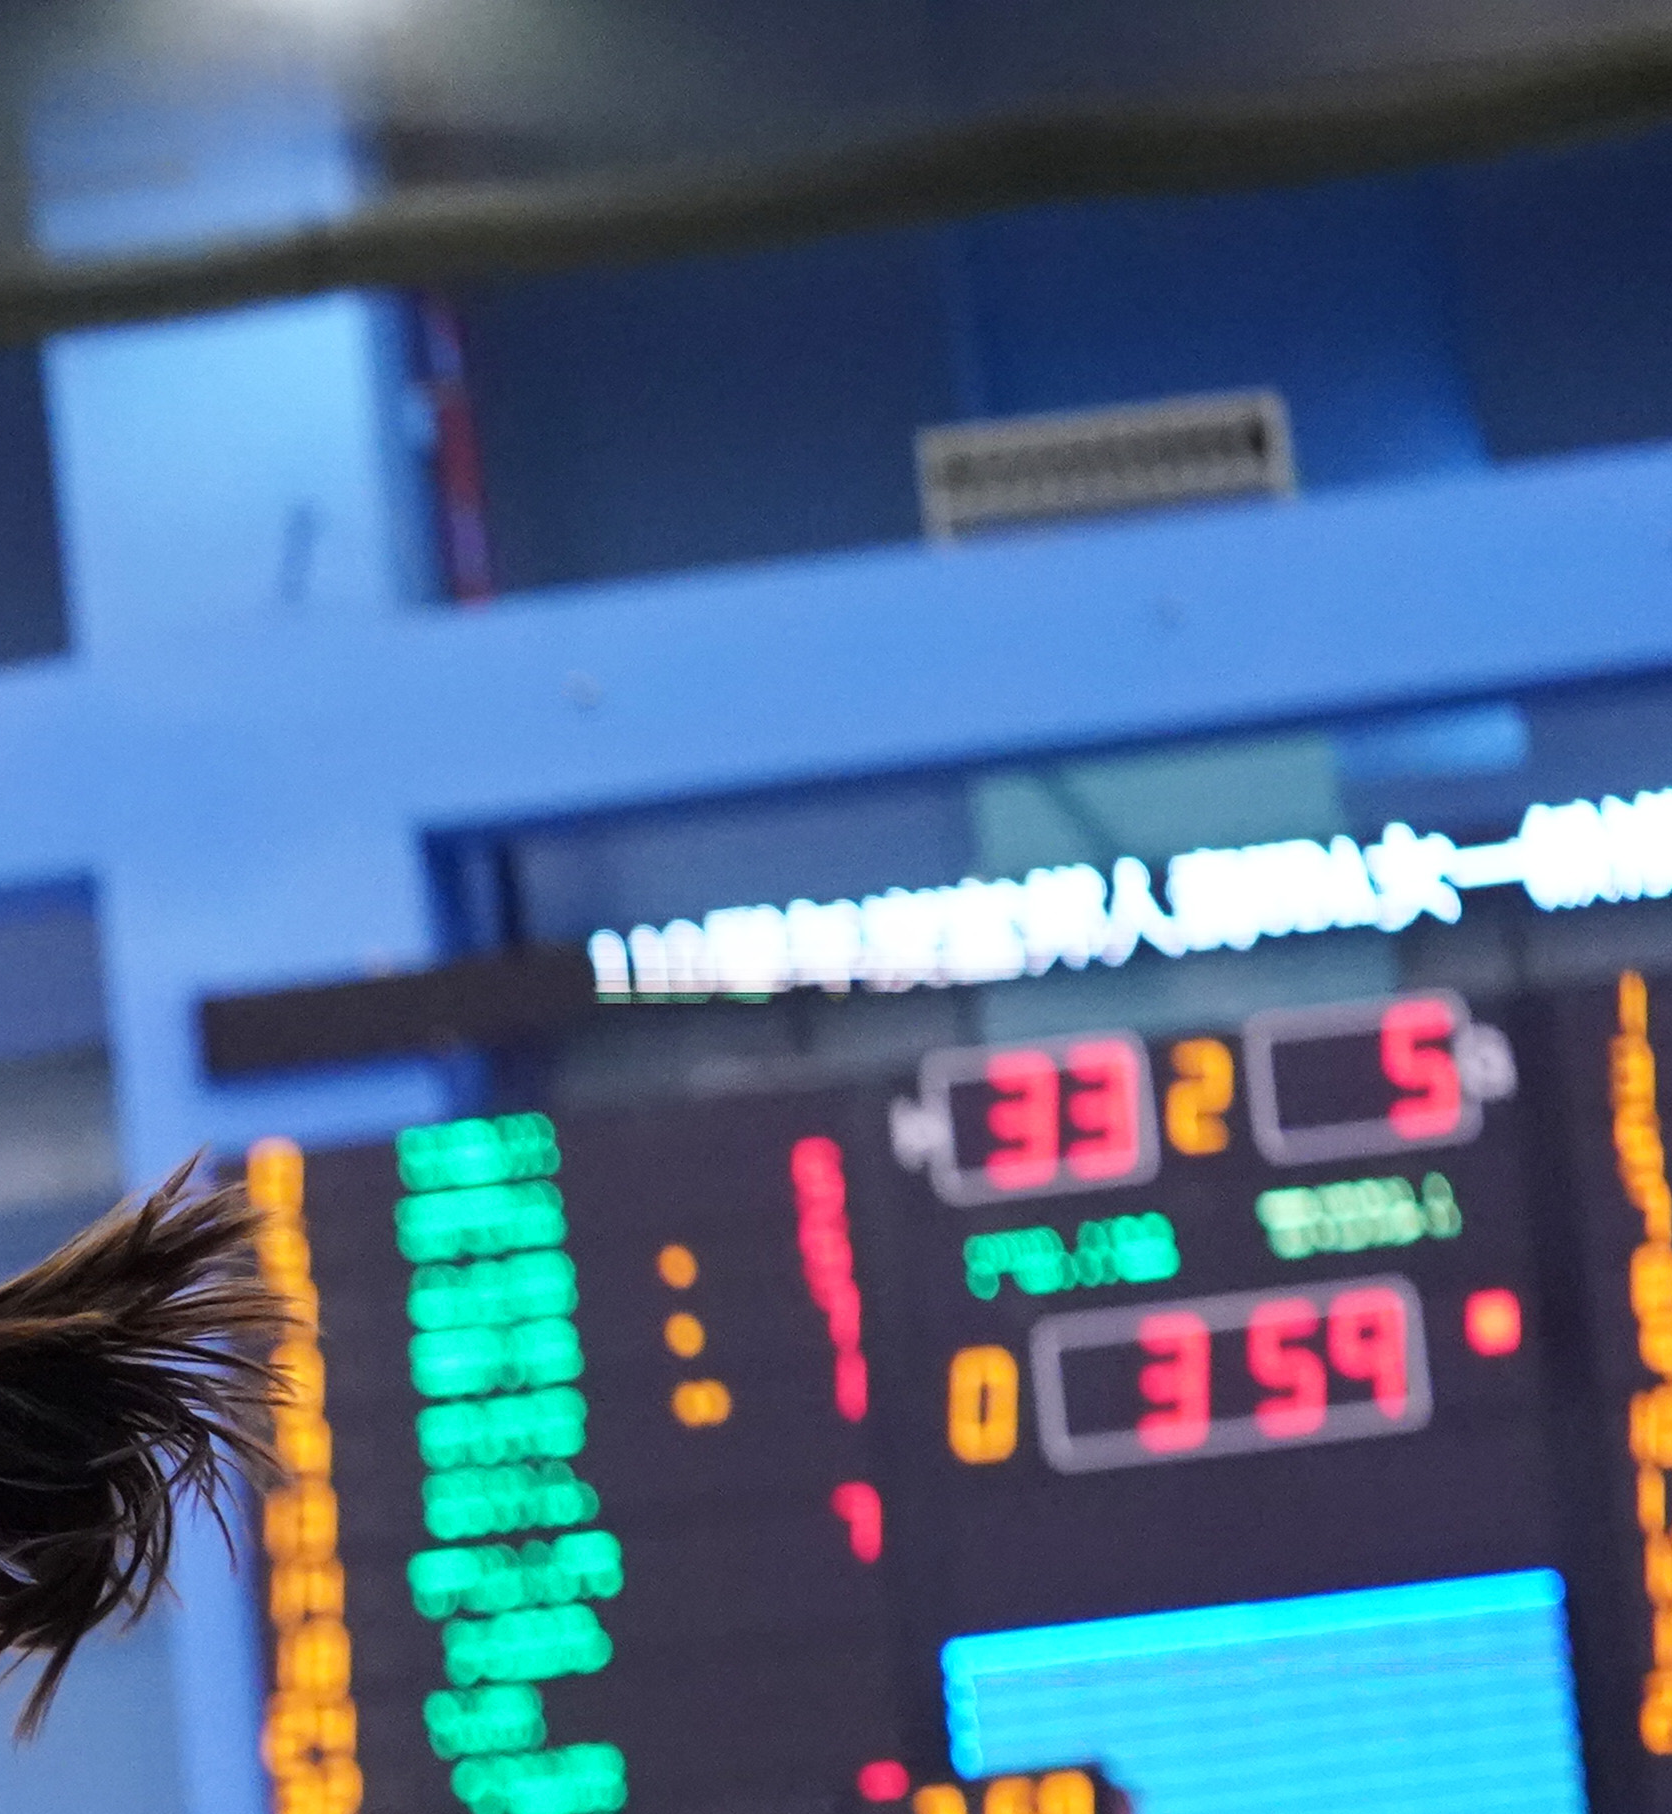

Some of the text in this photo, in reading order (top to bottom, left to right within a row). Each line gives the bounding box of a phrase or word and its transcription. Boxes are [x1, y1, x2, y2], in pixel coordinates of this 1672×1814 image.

[986, 999, 1461, 1191] 33 2 5
